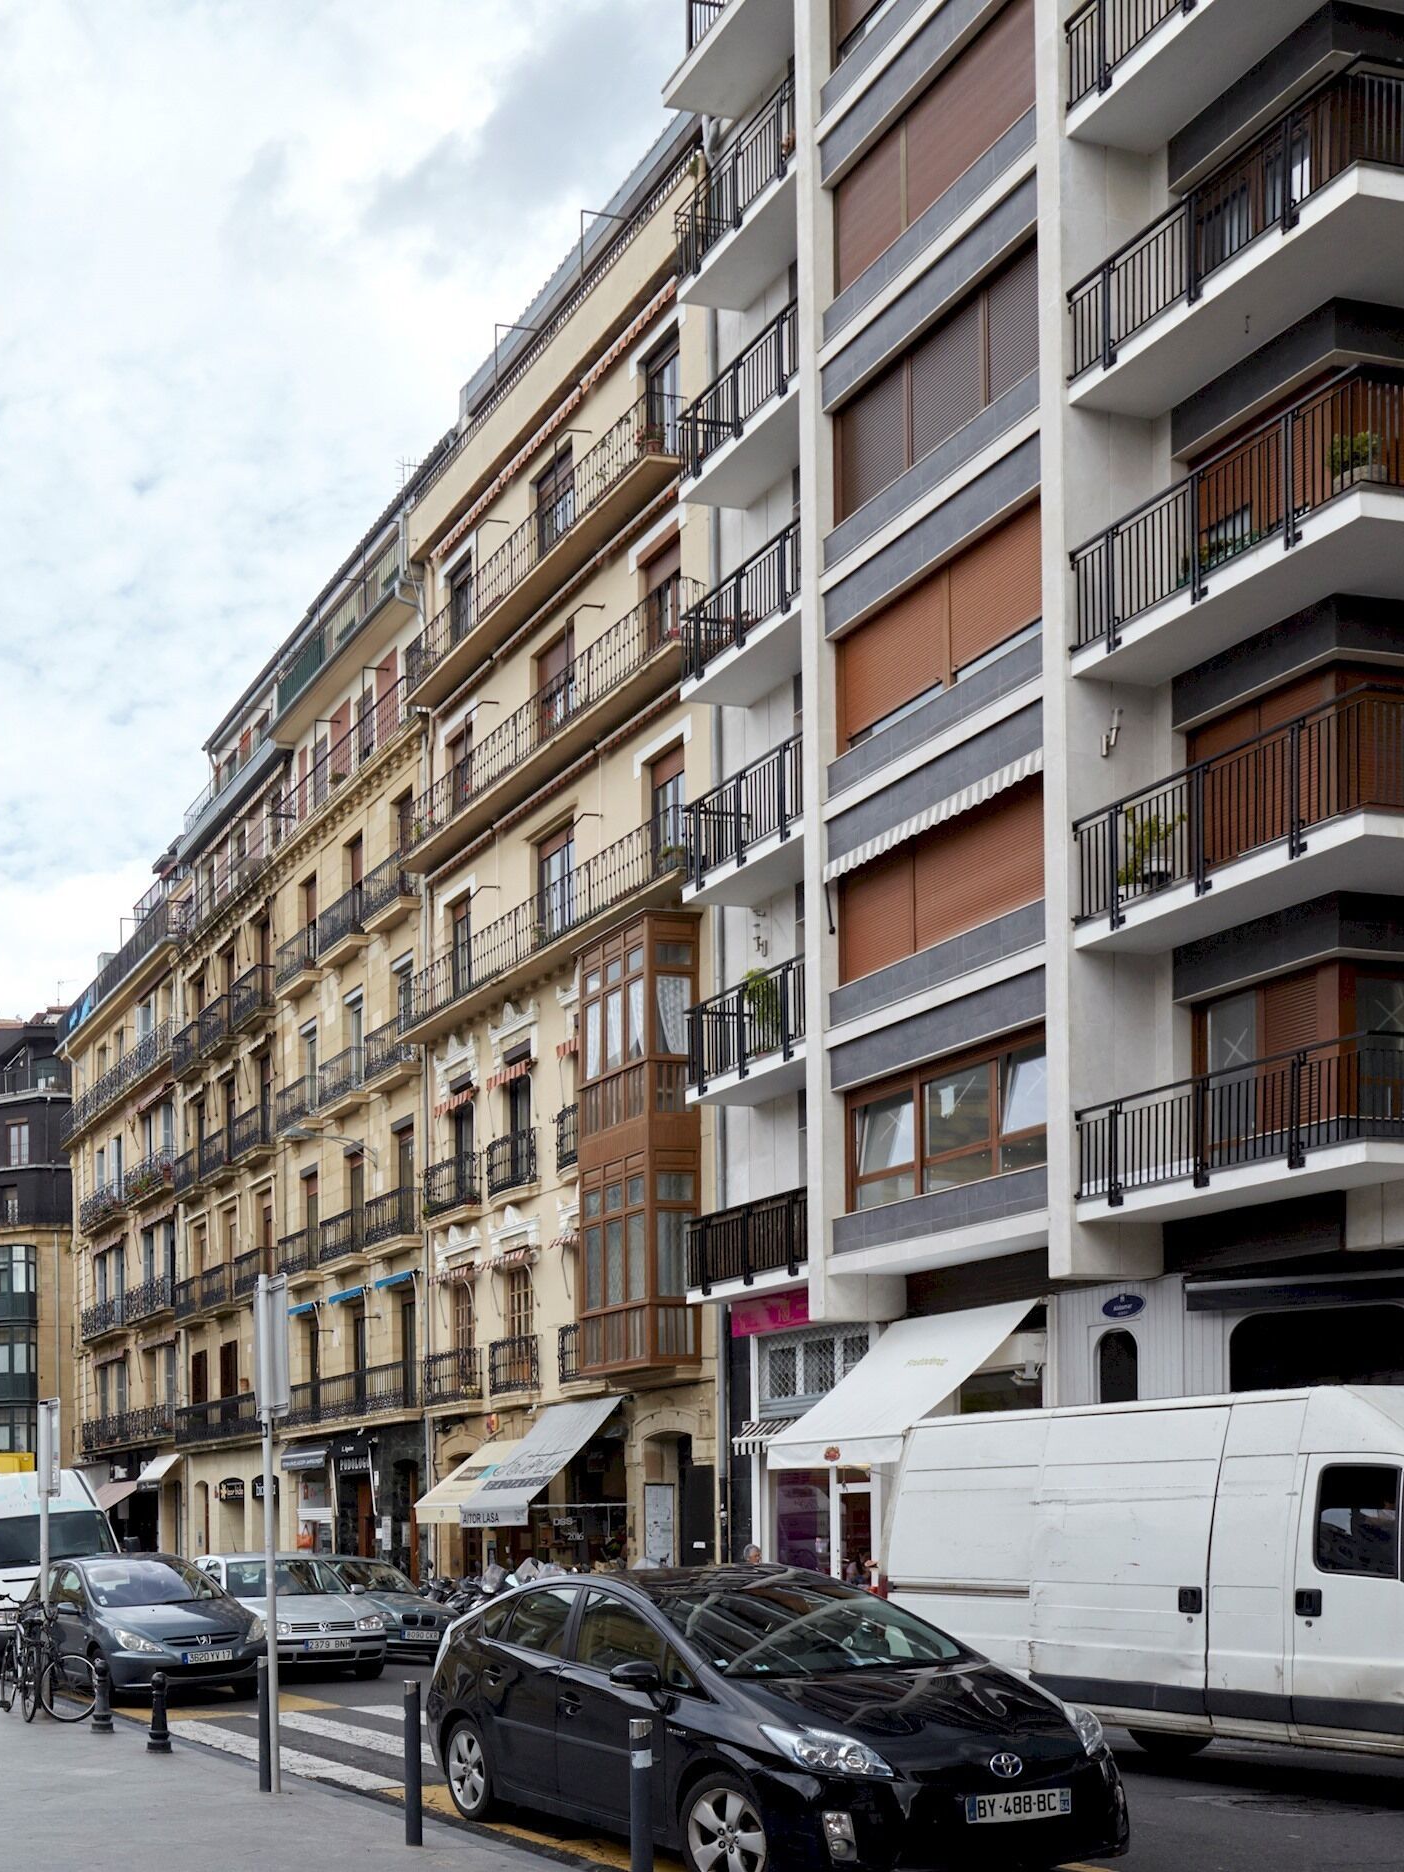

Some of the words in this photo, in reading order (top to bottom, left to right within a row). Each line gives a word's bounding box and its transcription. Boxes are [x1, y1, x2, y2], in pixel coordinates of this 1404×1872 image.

[462, 1513, 482, 1524] AITOR
[482, 1512, 500, 1523] LASA
[308, 1640, 330, 1649] 2379
[335, 1640, 351, 1649] BNH
[189, 1652, 210, 1663] 3620
[222, 1650, 232, 1661] 17
[1060, 1800, 1069, 1810] 64
